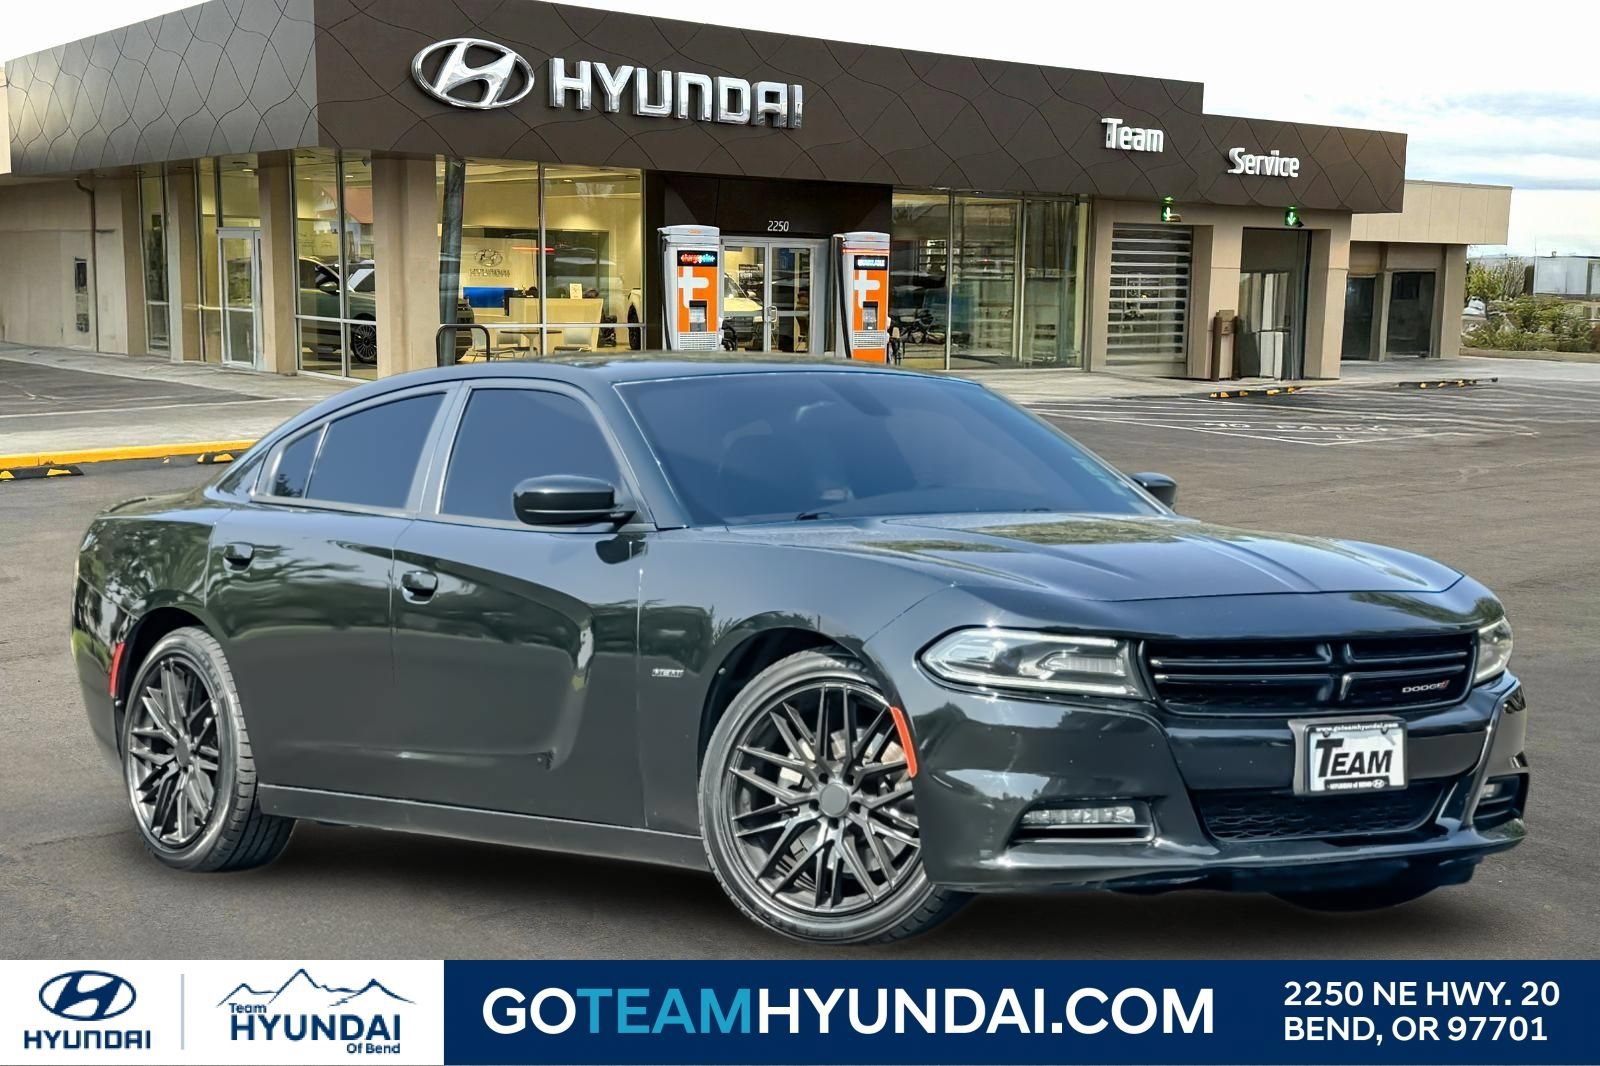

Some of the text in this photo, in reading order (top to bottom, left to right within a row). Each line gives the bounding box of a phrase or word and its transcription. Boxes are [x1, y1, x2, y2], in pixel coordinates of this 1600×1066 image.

[548, 57, 803, 129] HYUNDAI
[1101, 117, 1164, 152] Team
[1227, 147, 1300, 178] Service
[767, 220, 790, 232] 2250
[1402, 681, 1443, 693] DODGE
[1315, 738, 1393, 778] TEAM
